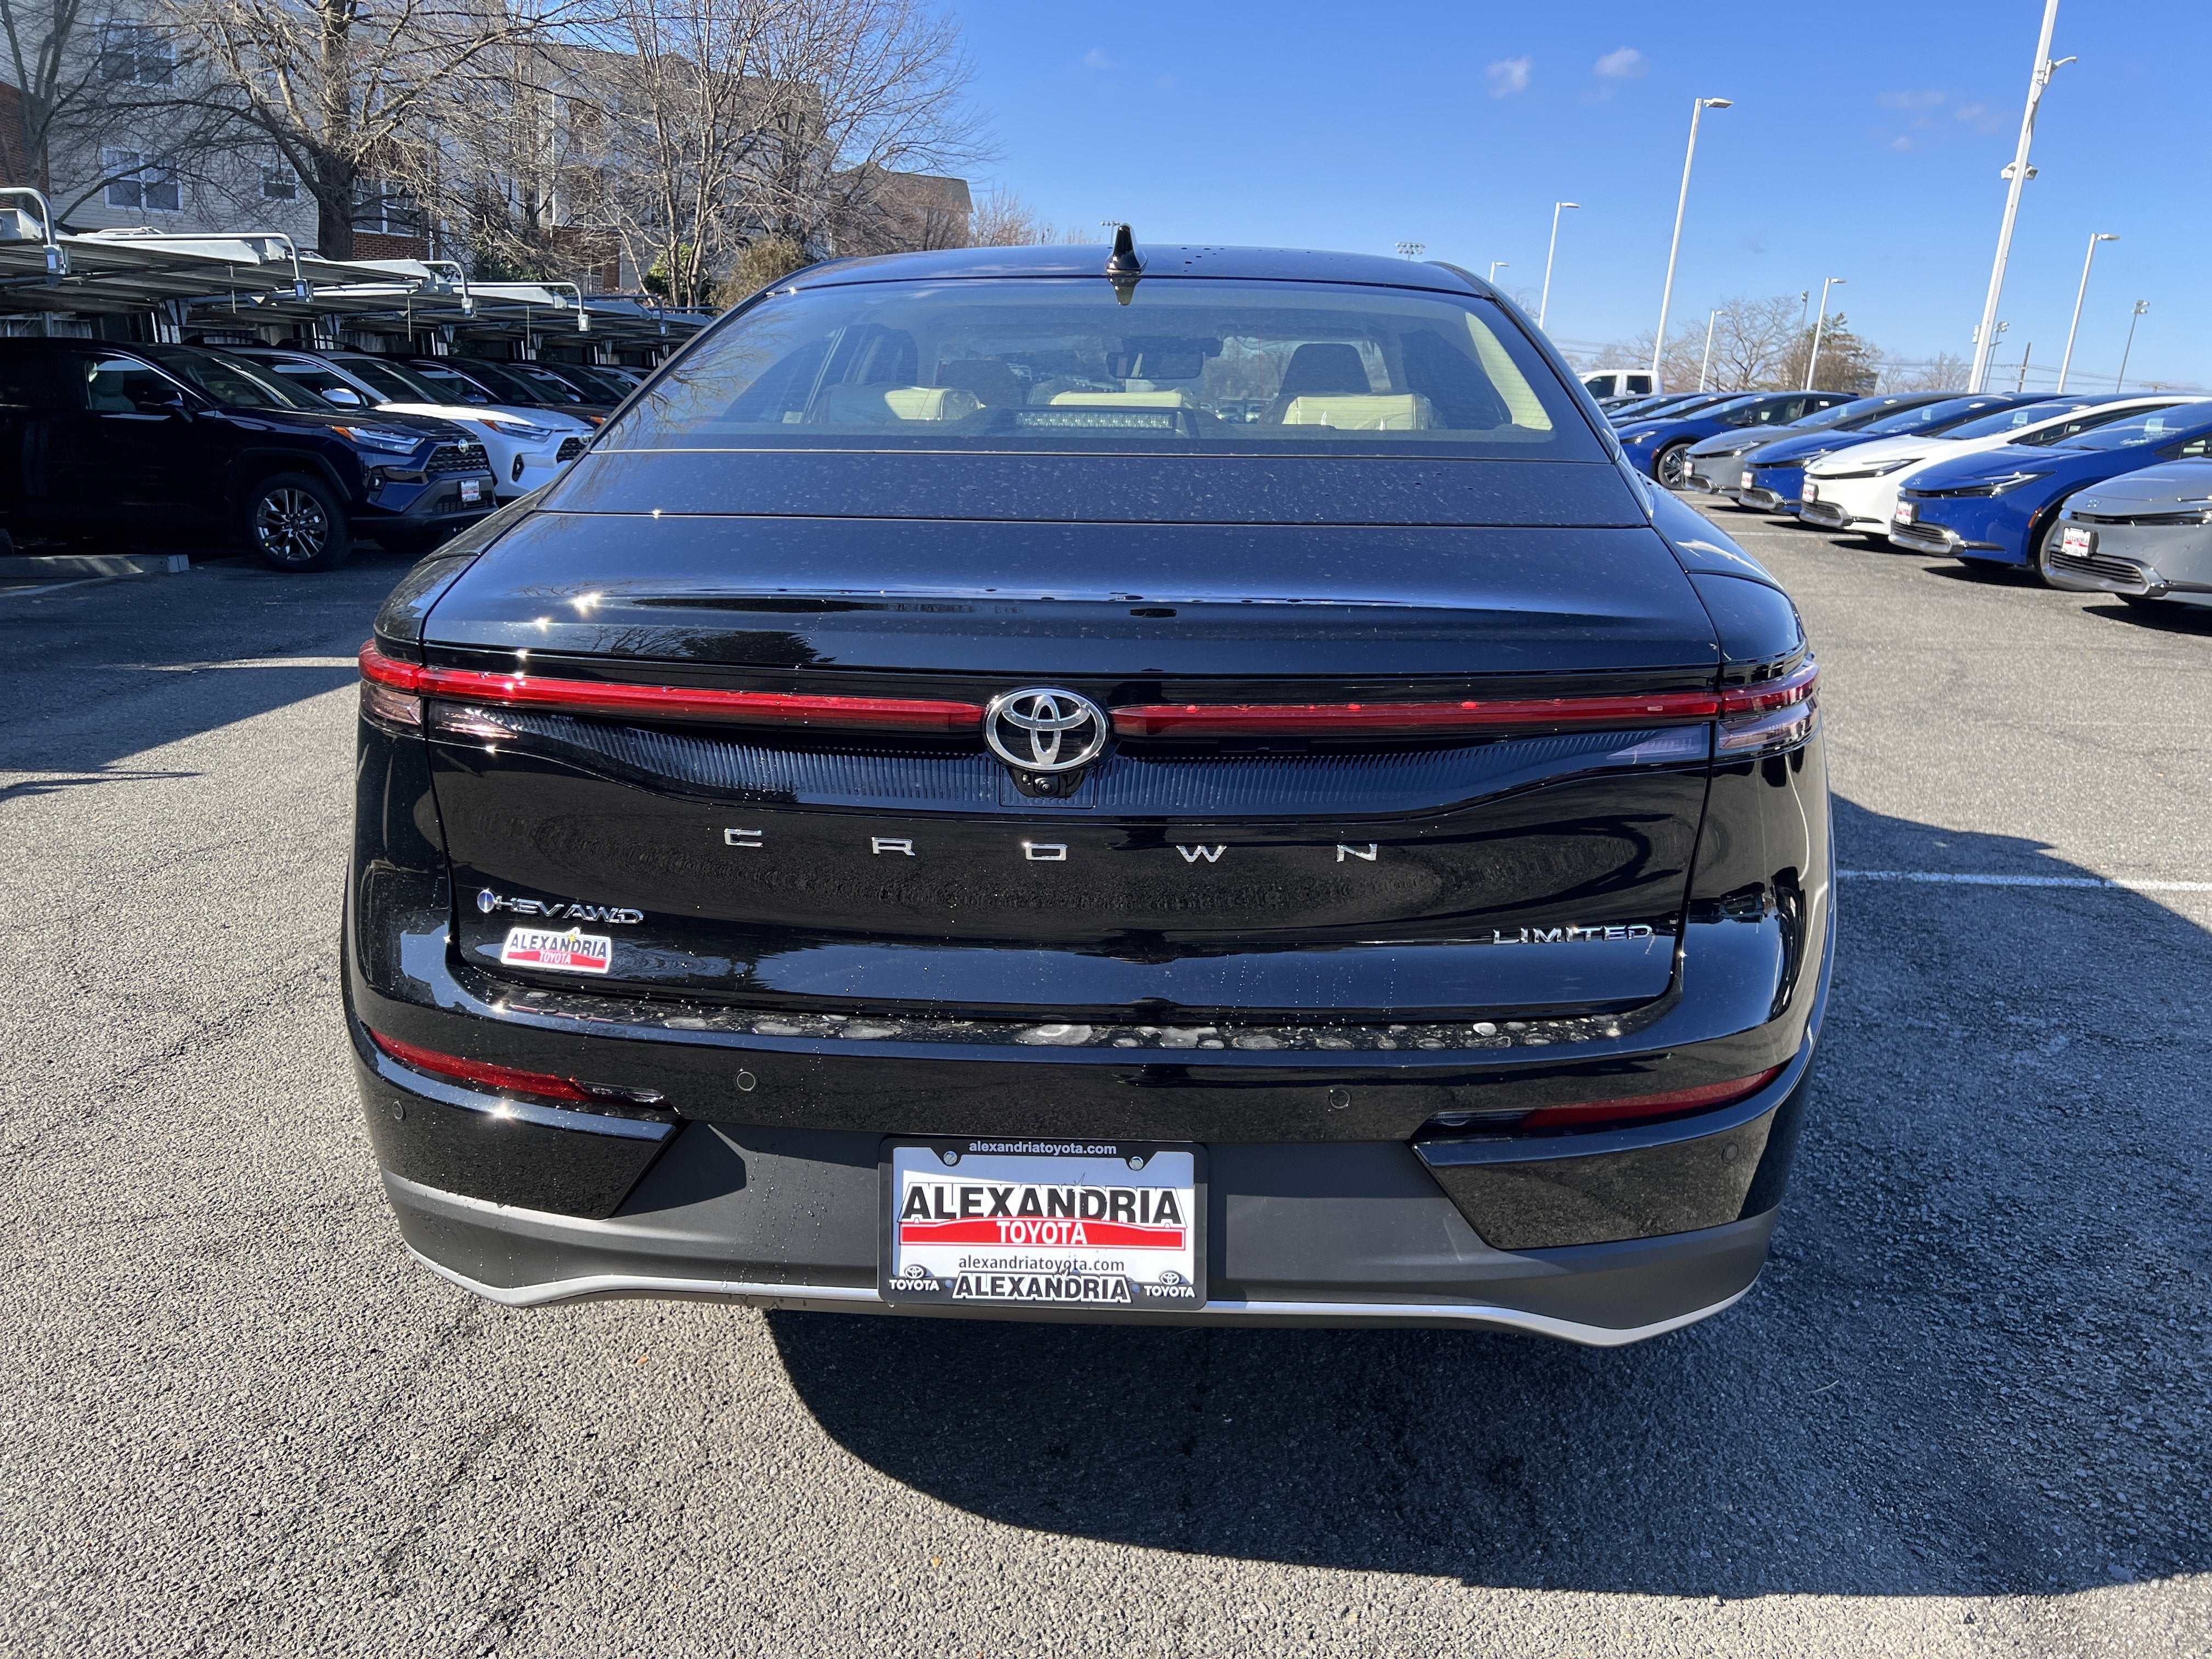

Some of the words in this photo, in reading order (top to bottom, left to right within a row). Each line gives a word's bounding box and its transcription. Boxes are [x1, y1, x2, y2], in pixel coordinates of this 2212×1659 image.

[724, 828, 1378, 862] CROWN
[1493, 923, 1653, 945] LIMITED
[510, 934, 606, 958] ALEXANDRIA
[539, 950, 571, 964] TOYOTA
[969, 1141, 1117, 1155] alexandriatoyota.com
[901, 1185, 1183, 1226] ALEXANDRIA
[996, 1221, 1088, 1245] TOYOTA
[958, 1255, 1125, 1273] alexandriatoyota.com
[889, 1279, 940, 1291] TOYOTA
[956, 1276, 1128, 1300] ALEXANDRIA
[1143, 1285, 1197, 1298] TOYOTA
